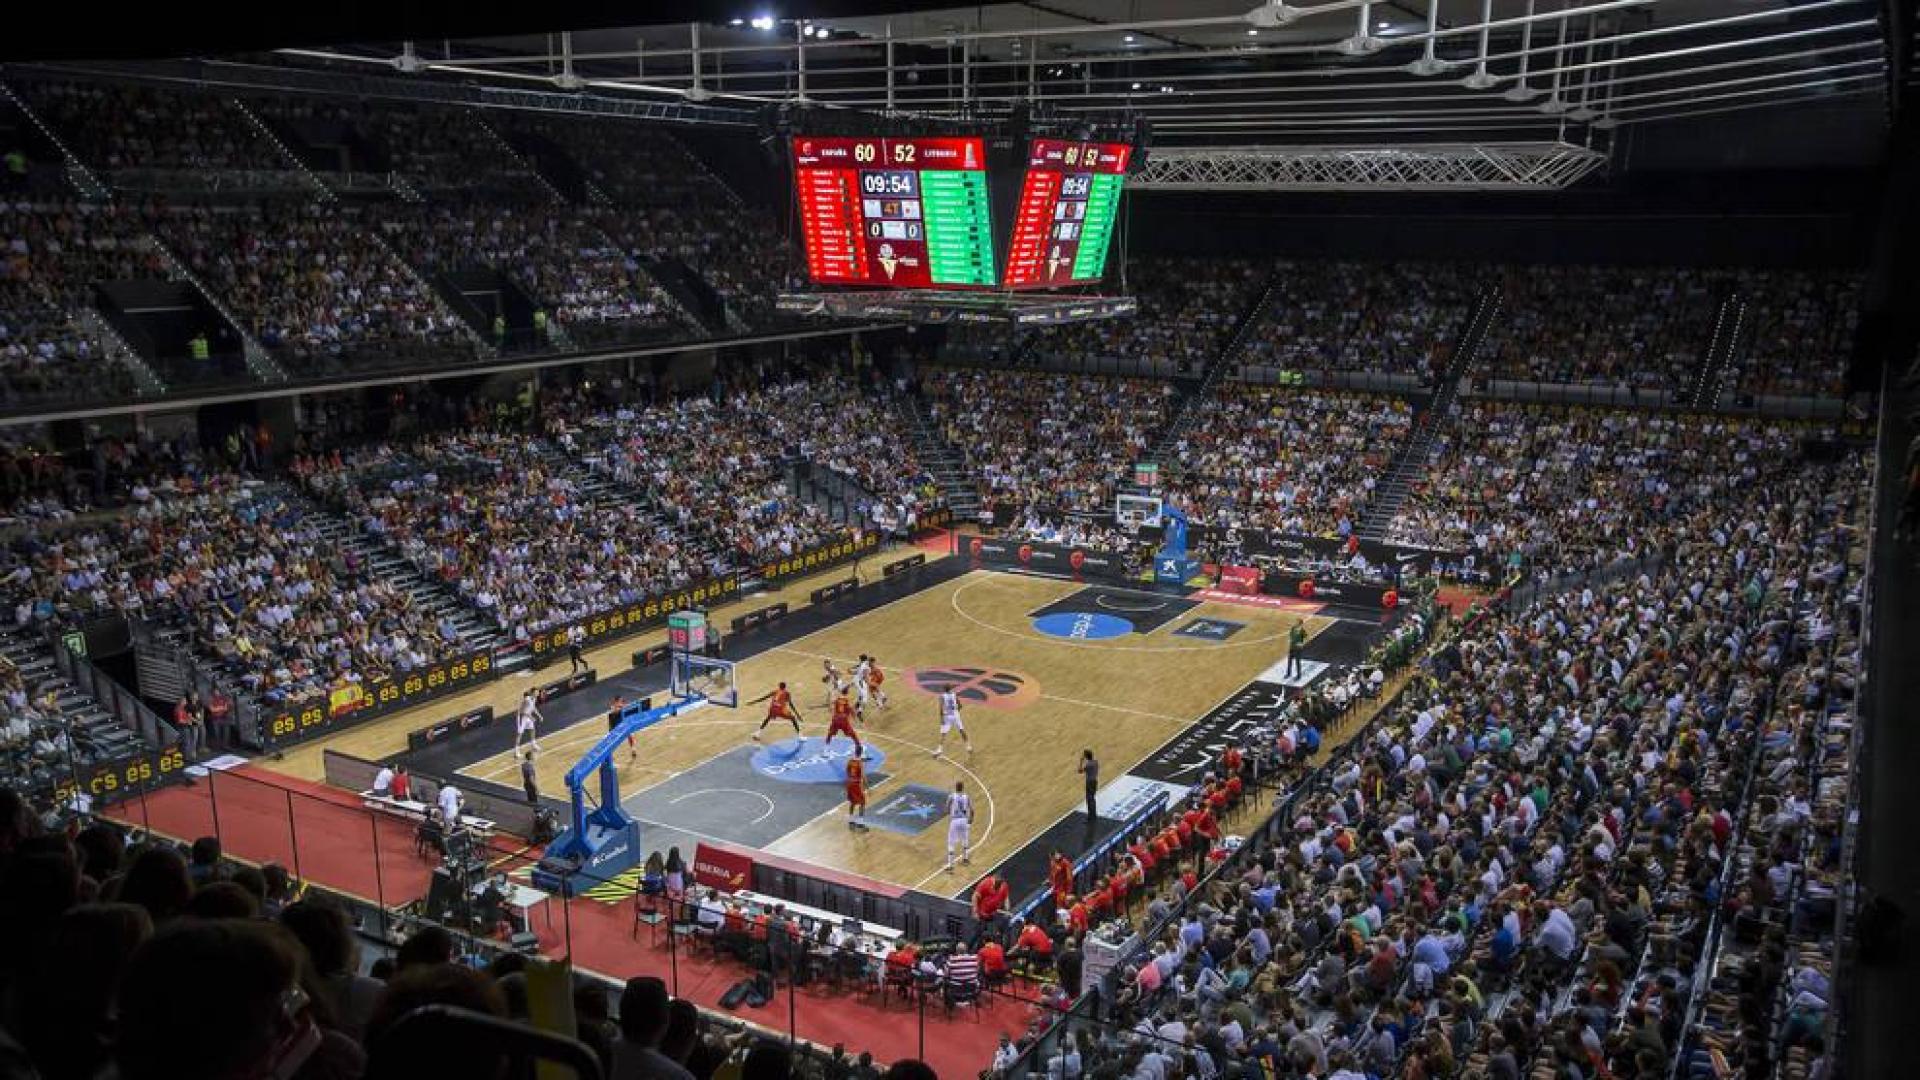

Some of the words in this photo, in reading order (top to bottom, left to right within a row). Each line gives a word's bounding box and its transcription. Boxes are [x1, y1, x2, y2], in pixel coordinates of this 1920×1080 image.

[854, 144, 876, 162] 60
[894, 144, 915, 162] 52
[864, 175, 912, 193] 09:54
[872, 222, 881, 237] 0
[908, 225, 918, 239] 0
[273, 716, 296, 735] es
[379, 686, 399, 702] es
[451, 664, 468, 680] es
[473, 656, 490, 672] es
[126, 763, 152, 782] es
[160, 752, 185, 773] es
